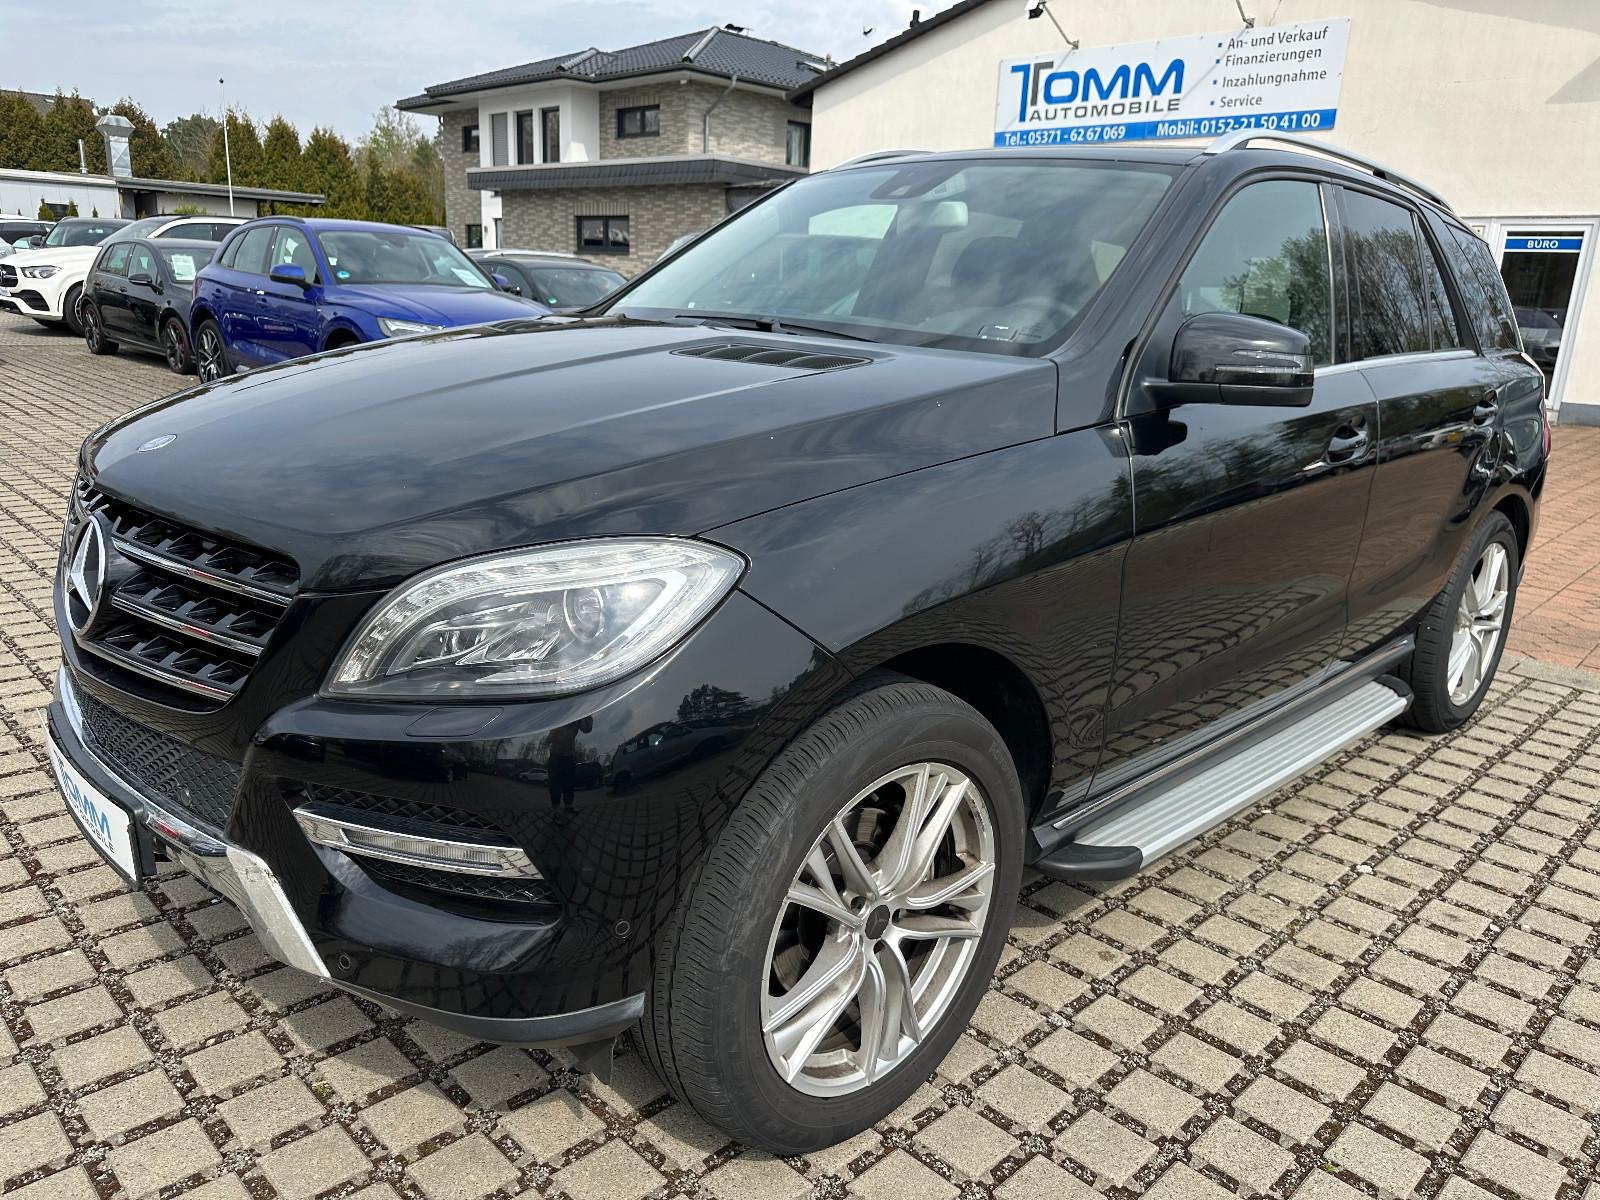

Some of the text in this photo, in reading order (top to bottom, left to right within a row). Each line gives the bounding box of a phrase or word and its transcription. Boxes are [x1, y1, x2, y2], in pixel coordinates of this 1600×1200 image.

[1228, 26, 1329, 50] An- und Verkauf
[1225, 48, 1322, 67] Finanzierungen
[1222, 69, 1327, 88] Inzahlungnahme
[1029, 98, 1181, 122] AUTOMOBILE
[1219, 94, 1263, 108] Service
[1157, 119, 1198, 136] Mobil:
[1260, 115, 1277, 130] 50
[1280, 114, 1297, 129] 41
[1301, 112, 1321, 127] 00
[1005, 133, 1027, 147] Tel.:
[1028, 130, 1061, 145] 05371
[1070, 128, 1084, 142] 62
[1086, 127, 1101, 140] 67
[1103, 125, 1126, 139] 069
[1527, 238, 1559, 249] BÜRO
